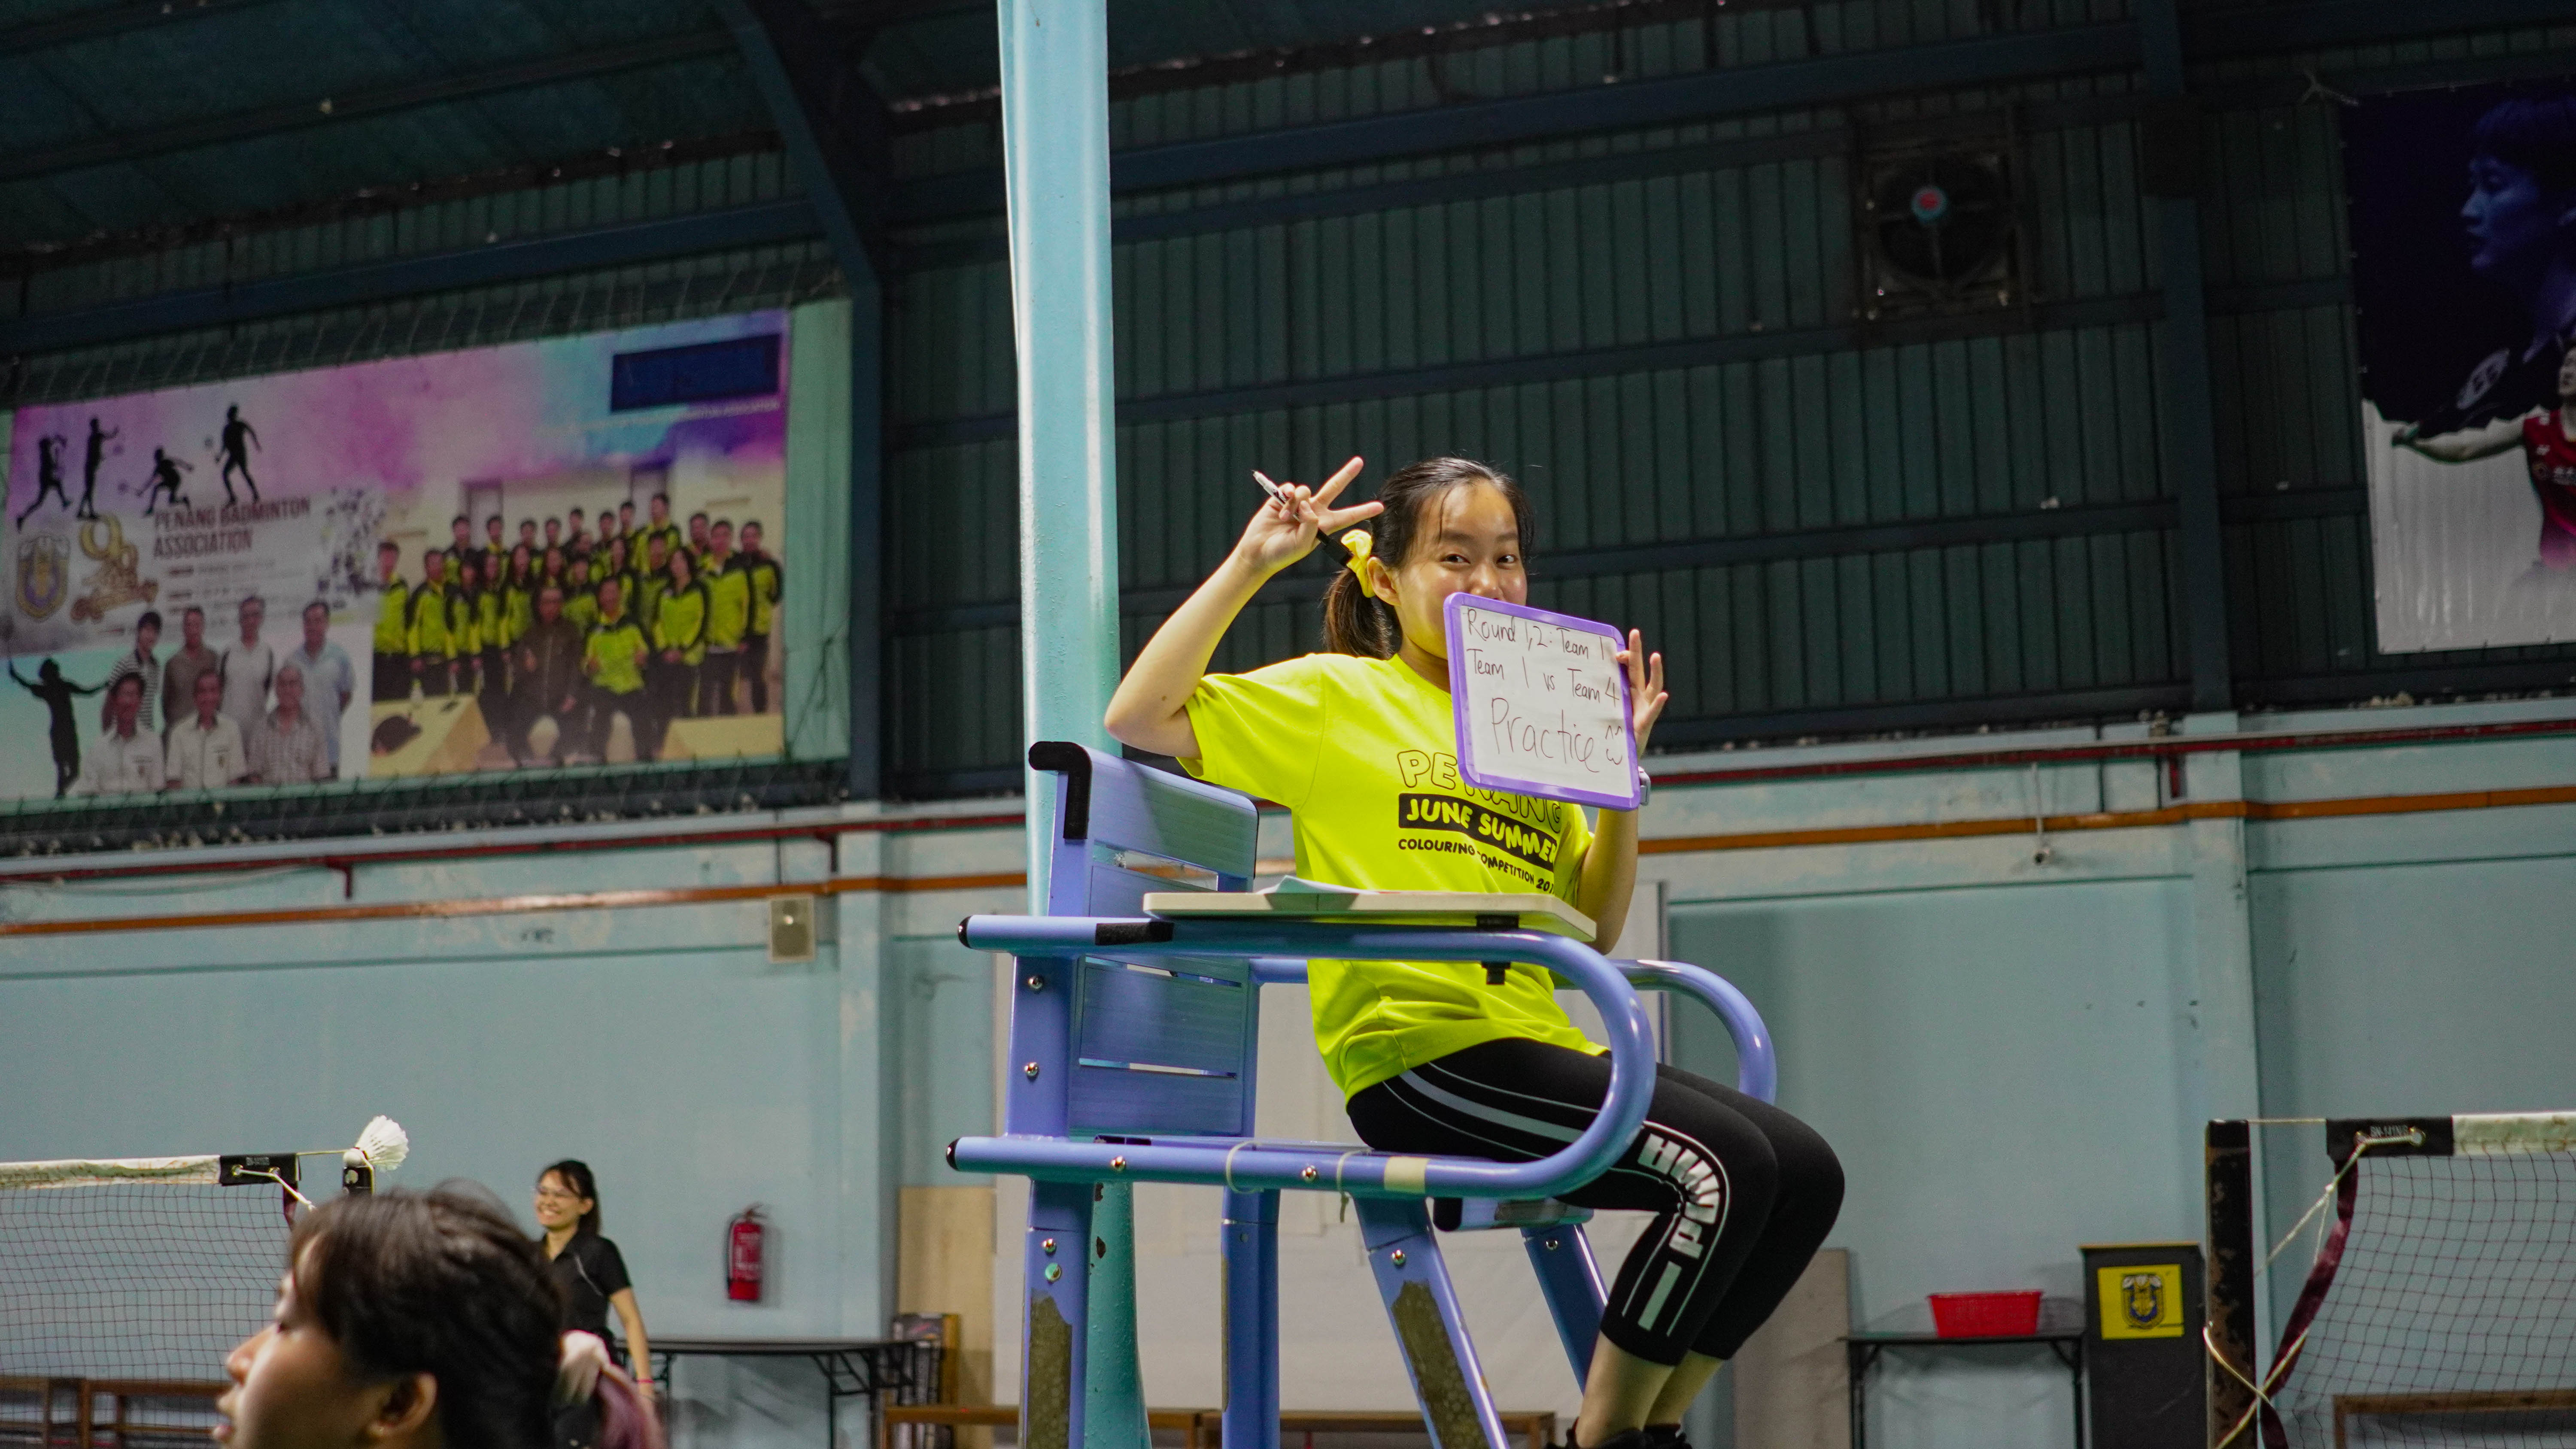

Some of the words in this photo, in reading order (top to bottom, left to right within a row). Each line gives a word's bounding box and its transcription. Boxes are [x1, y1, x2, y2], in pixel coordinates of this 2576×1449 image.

[155, 507, 215, 530] PENANG
[220, 497, 310, 526] BADMINTON
[154, 530, 252, 558] ASSOCIATION
[1467, 607, 1516, 641] Round
[1556, 627, 1589, 660] Team
[1599, 636, 1604, 660] 1
[1467, 649, 1504, 680] Team
[1522, 656, 1529, 688] 1
[1543, 673, 1555, 691] vs
[1567, 668, 1600, 703] Team
[1605, 676, 1619, 707] 4
[1491, 697, 1600, 773] Practice
[1397, 749, 1561, 834] PENG
[1406, 798, 1473, 829] JUNE
[1398, 839, 1475, 855] COLOURING
[1477, 851, 1534, 885] OMPETITION
